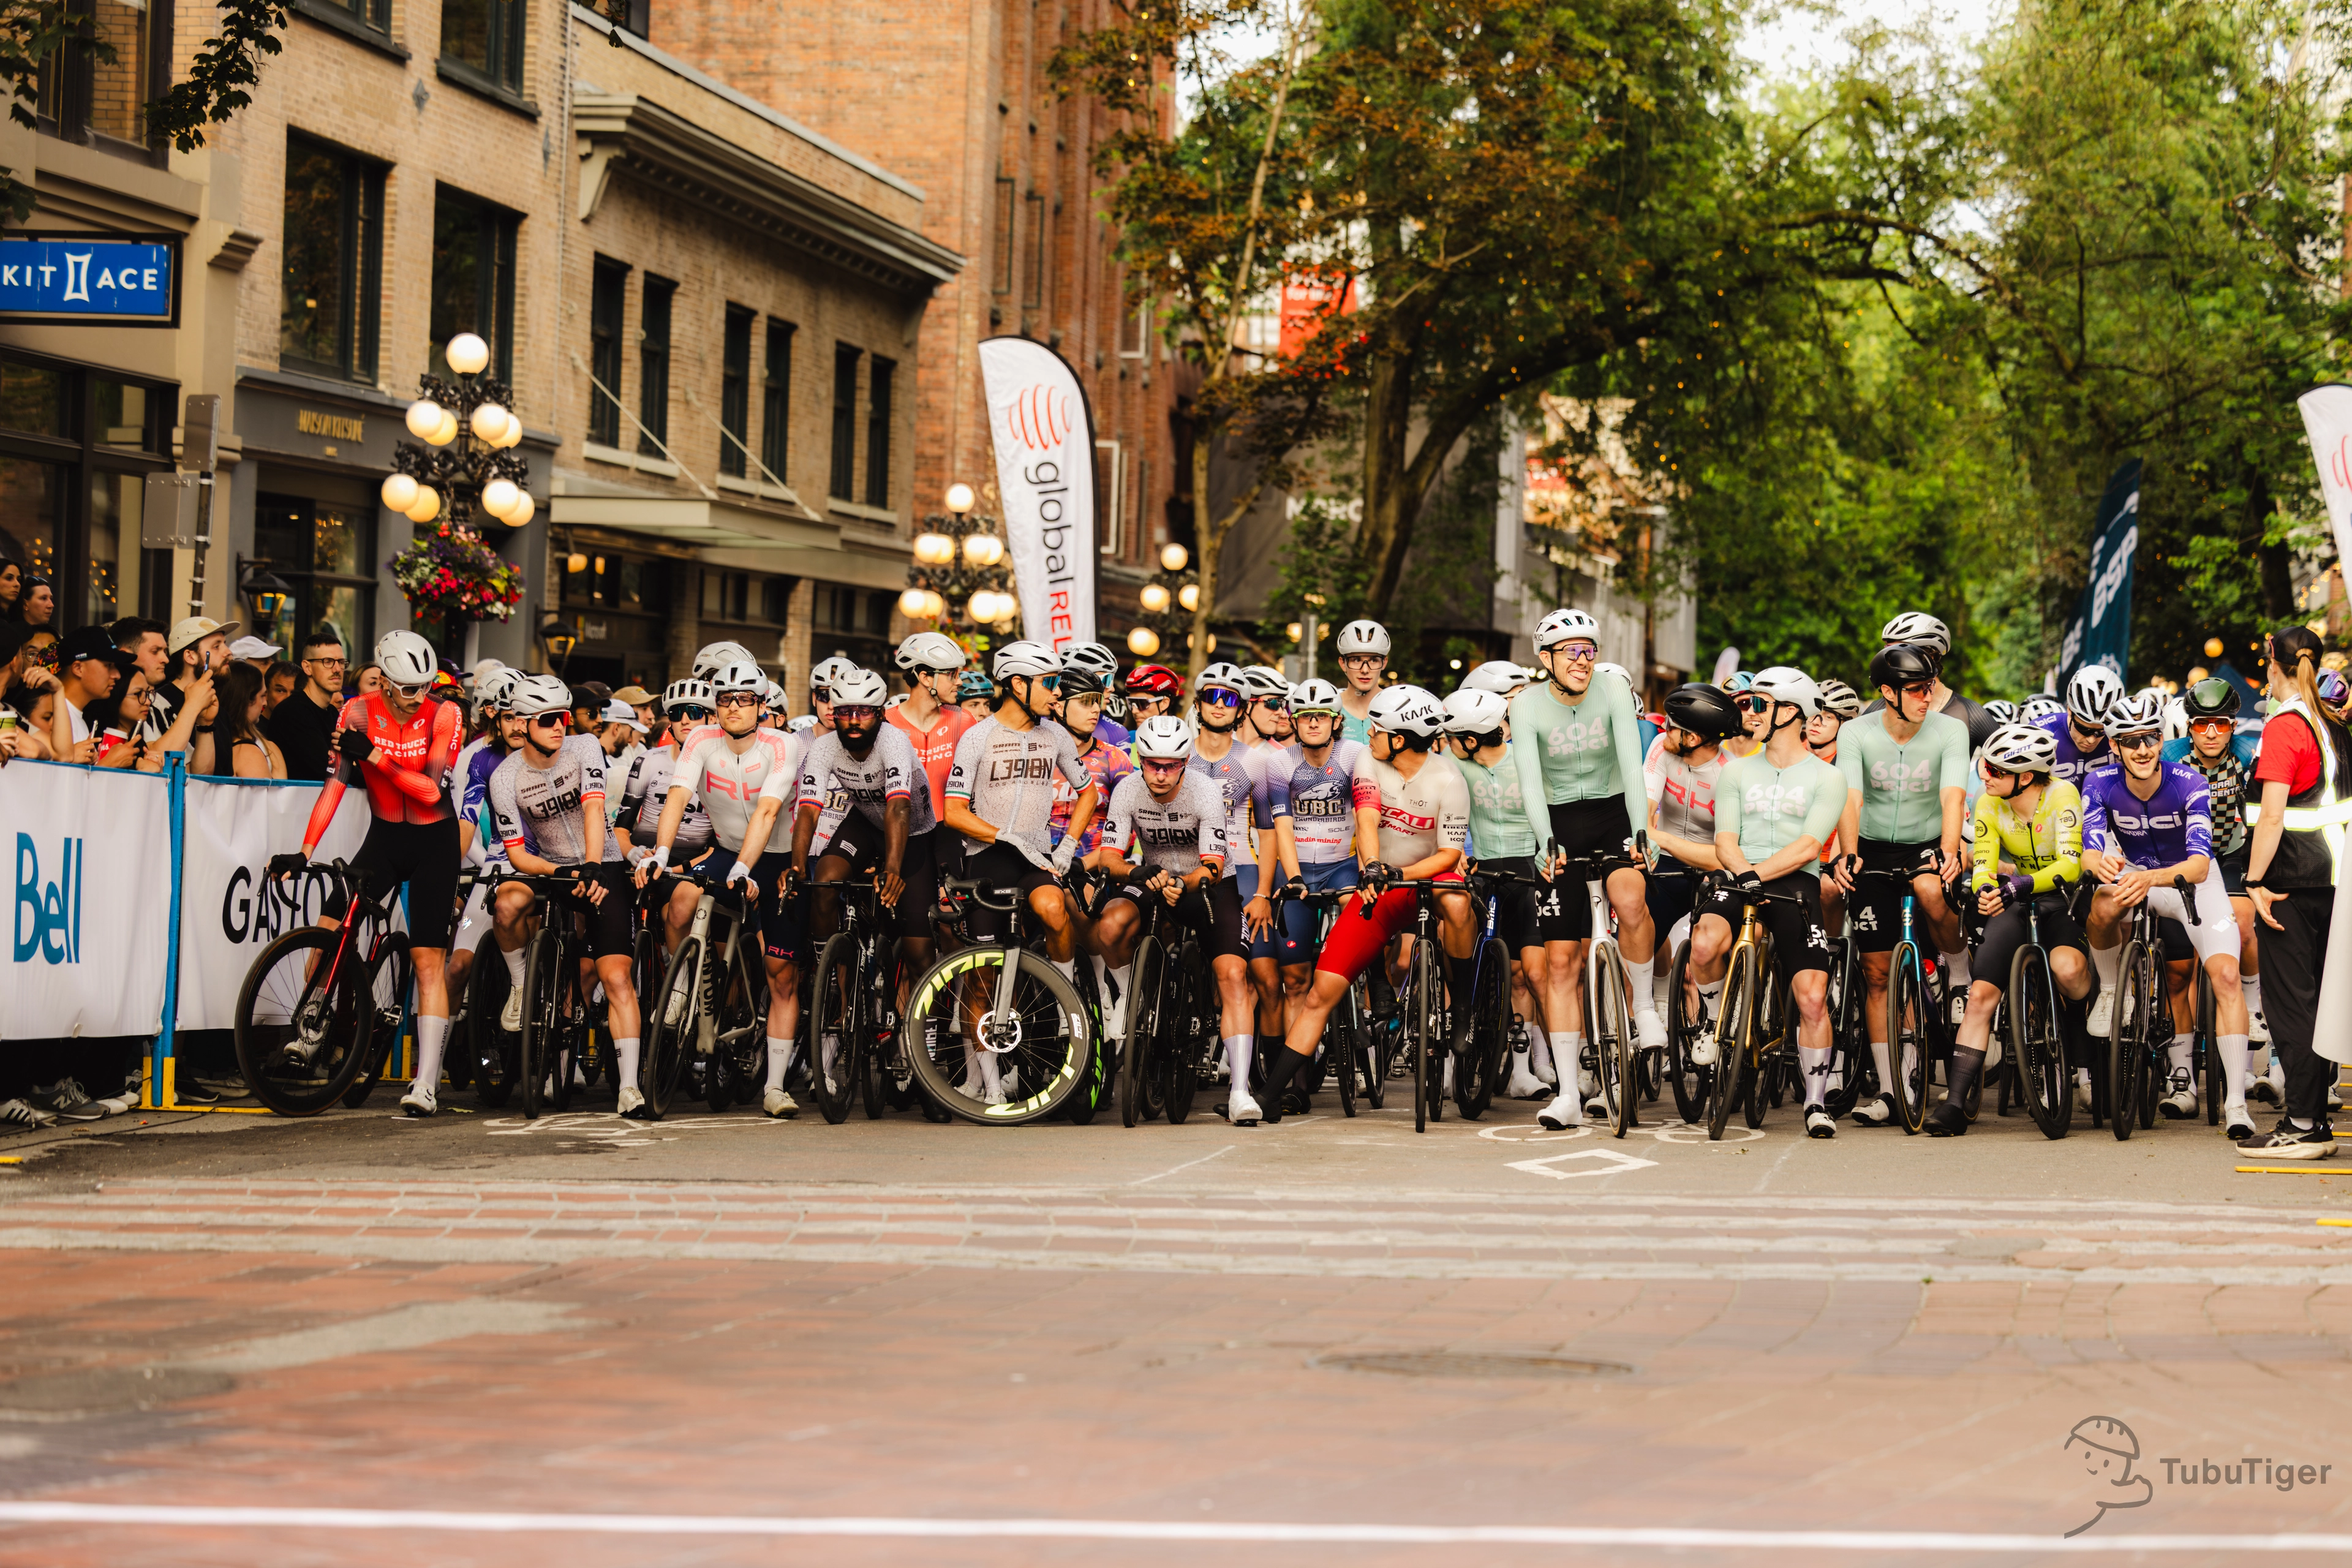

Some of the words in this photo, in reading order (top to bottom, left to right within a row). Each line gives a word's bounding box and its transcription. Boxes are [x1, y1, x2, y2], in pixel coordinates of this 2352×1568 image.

[2, 265, 57, 287] KIT
[96, 268, 157, 291] ACE
[1025, 461, 1074, 584] global
[1049, 590, 1073, 654] REL
[1400, 704, 1433, 722] KASK
[450, 706, 462, 751] MOSAIC
[1102, 715, 1123, 728] KASK
[2034, 715, 2057, 728] bici
[1547, 716, 1607, 746] 604
[374, 736, 394, 748] RED
[396, 737, 427, 750] TRUCK
[921, 742, 953, 757] TRUCK
[1547, 734, 1609, 758] PRJCT
[919, 752, 952, 763] CING
[2003, 744, 2033, 760] GIANT
[837, 767, 859, 777] SRAM
[1870, 759, 1932, 781] 604
[2096, 767, 2118, 778] bici
[2172, 767, 2194, 780] KASK
[521, 783, 546, 793] SRAM
[1472, 780, 1521, 800] 604
[1870, 777, 1932, 793] PRJCT
[1744, 783, 1806, 804] 604
[1293, 797, 1346, 816] UBC
[1409, 799, 1428, 808] THOT
[1473, 796, 1522, 809] PRJCT
[1744, 801, 1806, 818] PRJCT
[820, 810, 845, 821] ERBIRDS
[1138, 808, 1161, 816] SRAM
[2113, 809, 2182, 830] bici
[13, 832, 83, 965] Bell
[222, 865, 343, 944] GASTO
